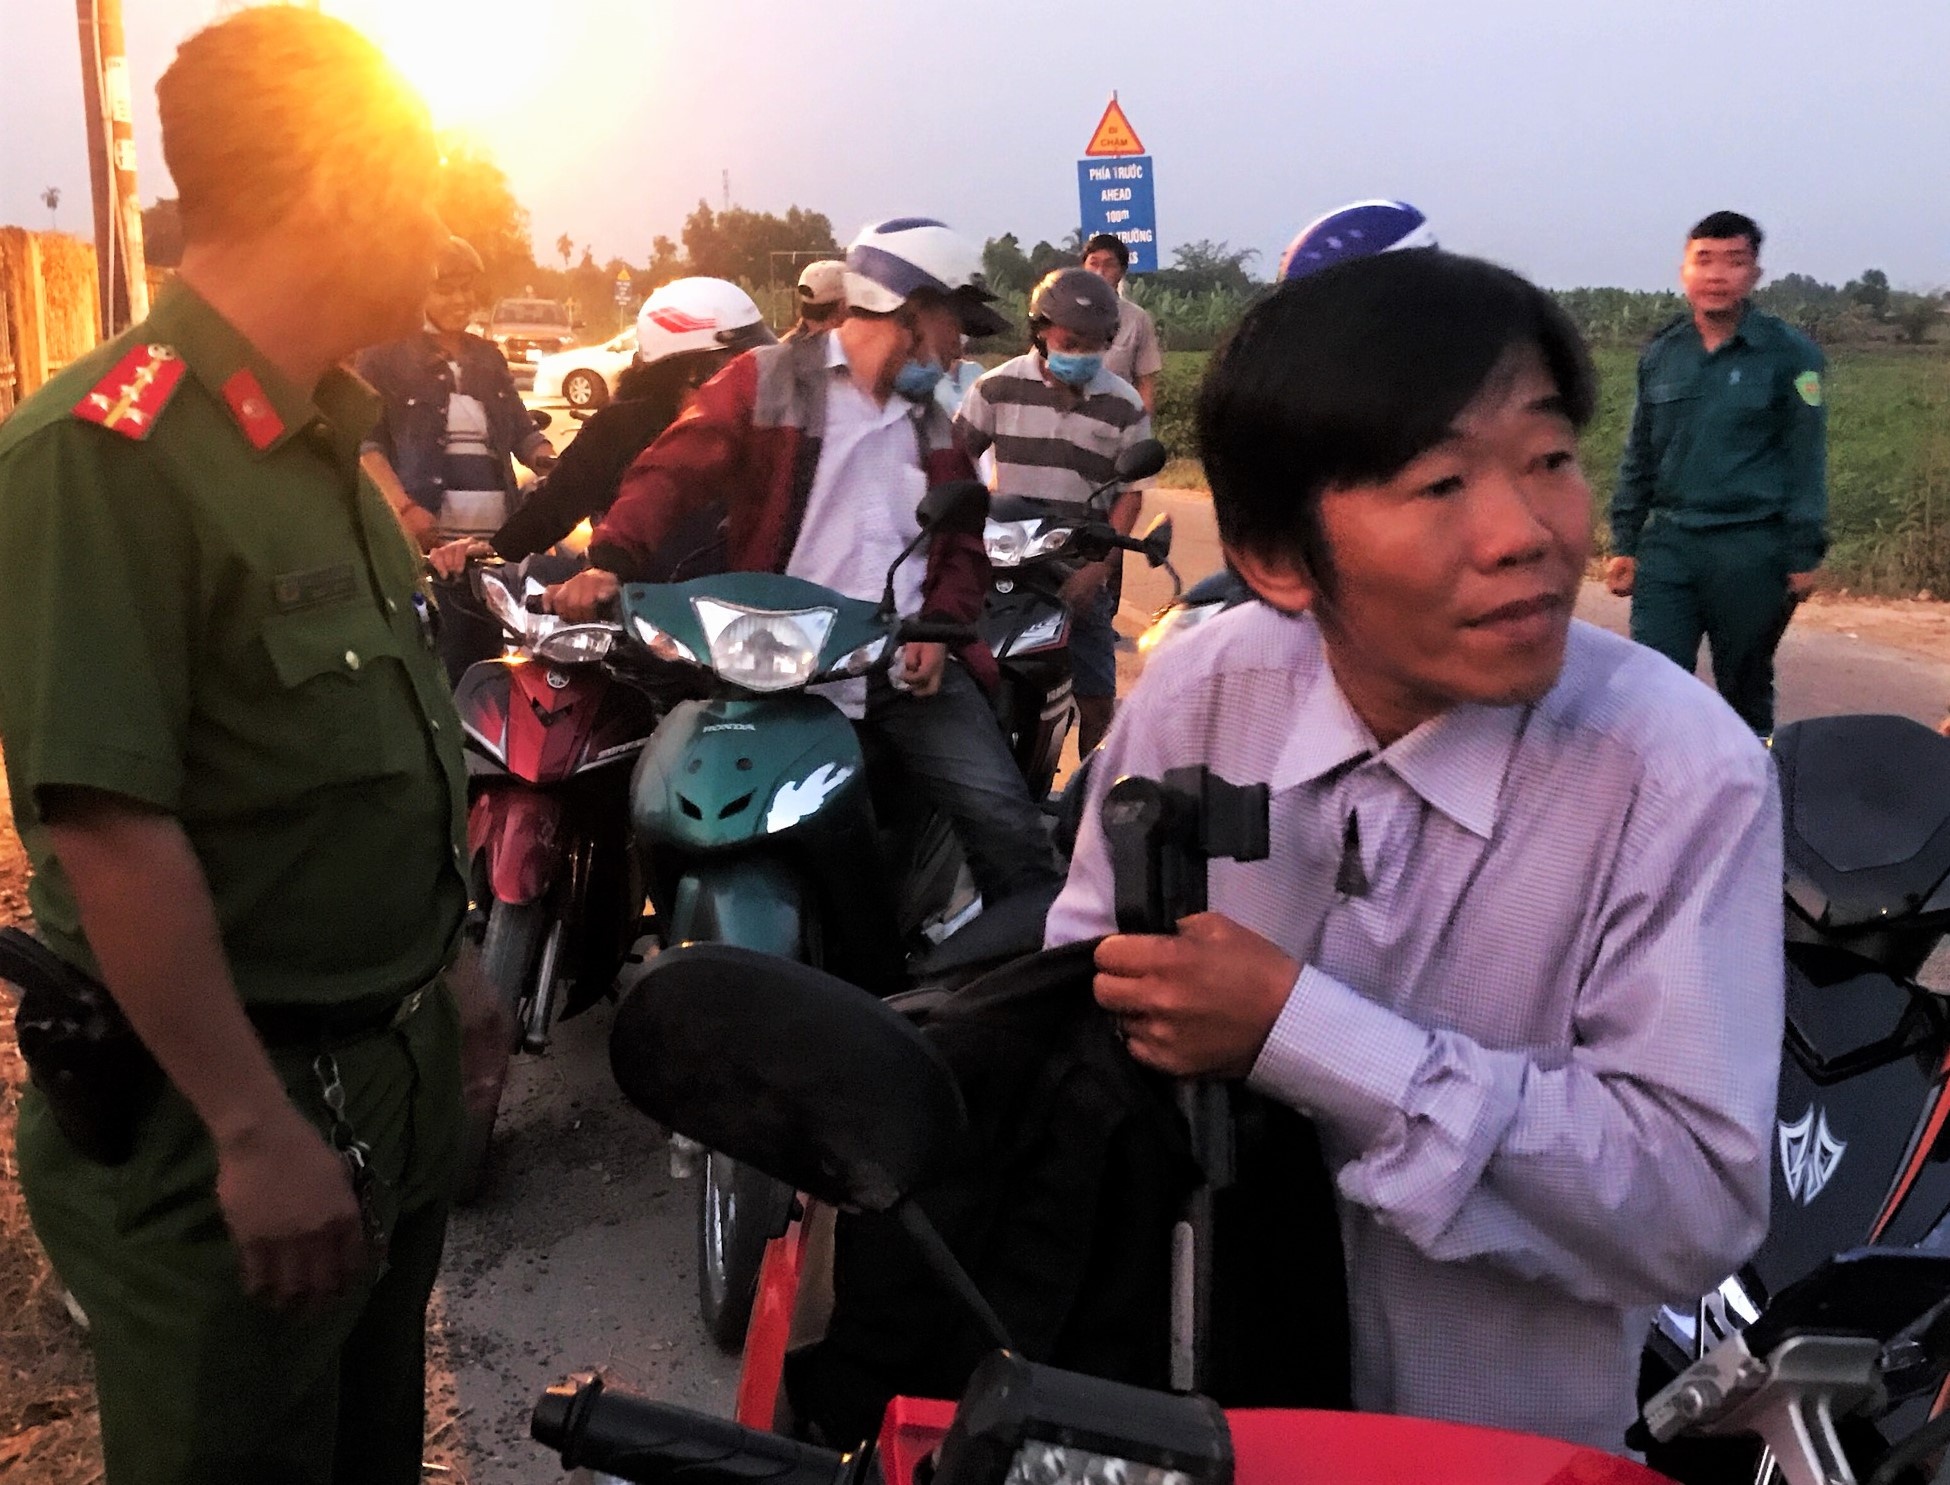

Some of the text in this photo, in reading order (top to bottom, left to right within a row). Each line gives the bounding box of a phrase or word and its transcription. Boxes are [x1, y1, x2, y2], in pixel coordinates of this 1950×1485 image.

[1089, 165, 1111, 181] PHÍA
[1101, 187, 1132, 202] AHEAD
[1105, 209, 1130, 223] 100m
[702, 723, 756, 733] HONDA
